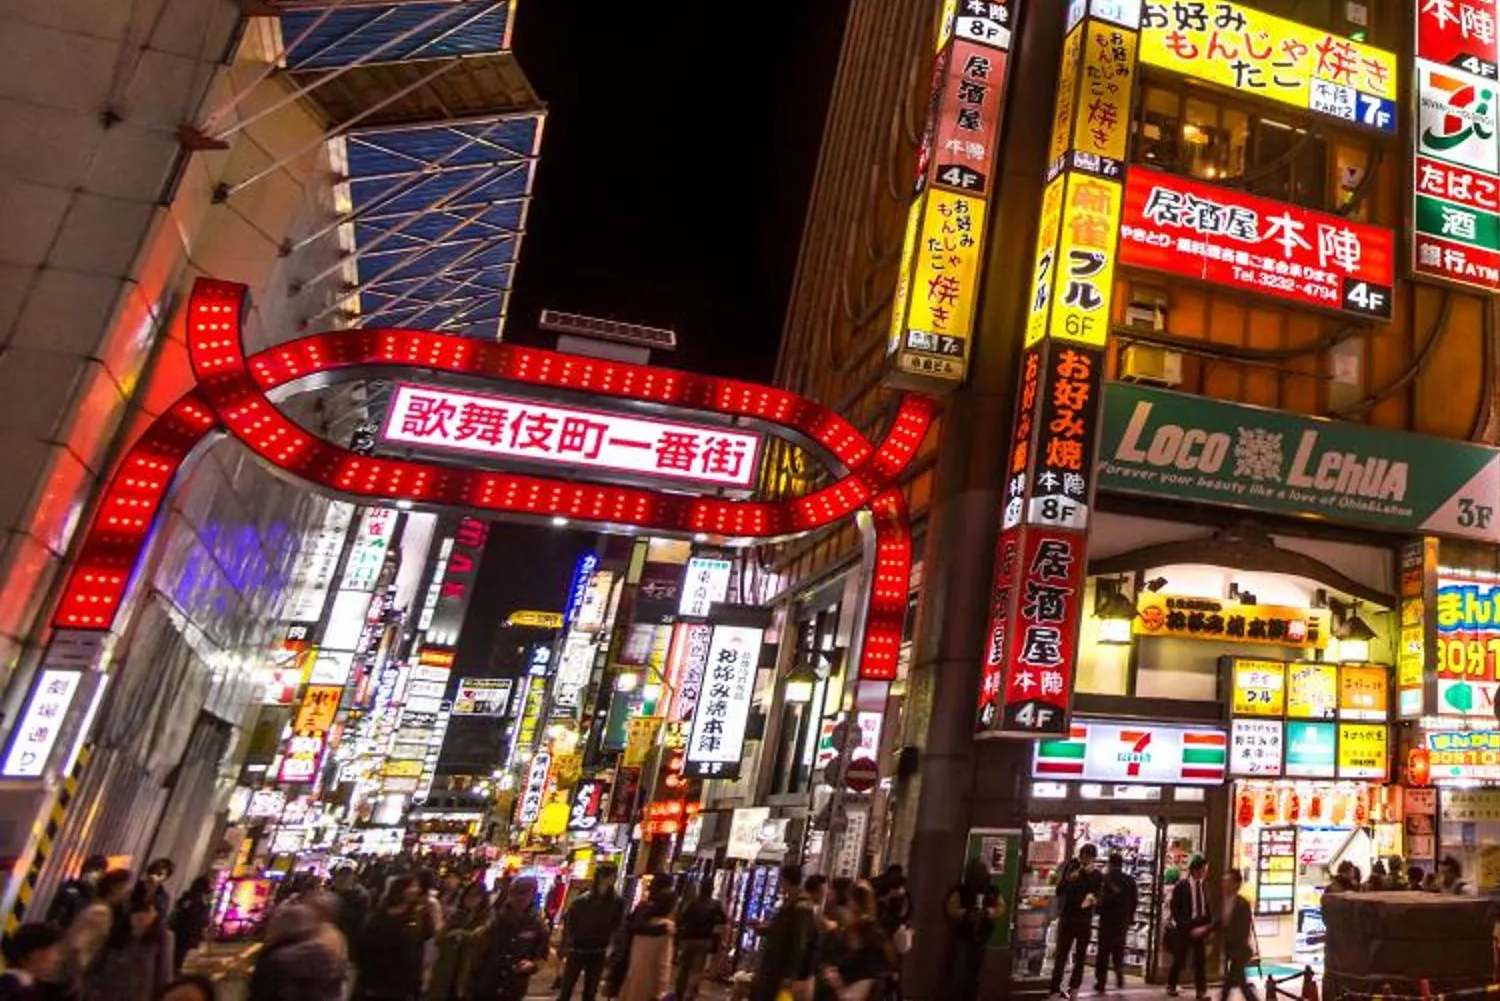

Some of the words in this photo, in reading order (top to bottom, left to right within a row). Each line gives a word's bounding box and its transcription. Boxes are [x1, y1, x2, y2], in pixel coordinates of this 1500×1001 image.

[969, 19, 1000, 40] 8F
[1142, 0, 1247, 33] お好み
[1165, 31, 1309, 63] もんじゃ
[1230, 60, 1301, 89] たこ
[1460, 55, 1497, 80] 4F
[957, 55, 991, 131] 居酒屋
[1363, 95, 1391, 127] 7F
[940, 165, 978, 188] 4F
[1420, 164, 1498, 208] たばこ
[953, 199, 975, 249] お好み
[1144, 186, 1261, 244] 居酒屋
[1262, 211, 1363, 274] 本陣
[1440, 206, 1477, 241] 酒
[927, 238, 945, 270] たこ
[1063, 250, 1106, 310] ブル
[927, 275, 962, 331] 焼き
[1347, 283, 1385, 311] 4F
[1064, 314, 1097, 338] 6F
[1045, 351, 1092, 471] お好み焼
[401, 394, 749, 478] 歌舞伎町一番街
[1036, 469, 1086, 498] 本陣
[1040, 499, 1076, 524] 8F
[1456, 497, 1493, 529] 3F
[1022, 540, 1074, 667] 居酒屋
[1012, 669, 1064, 697] 本陣
[1014, 703, 1053, 729] 4F
